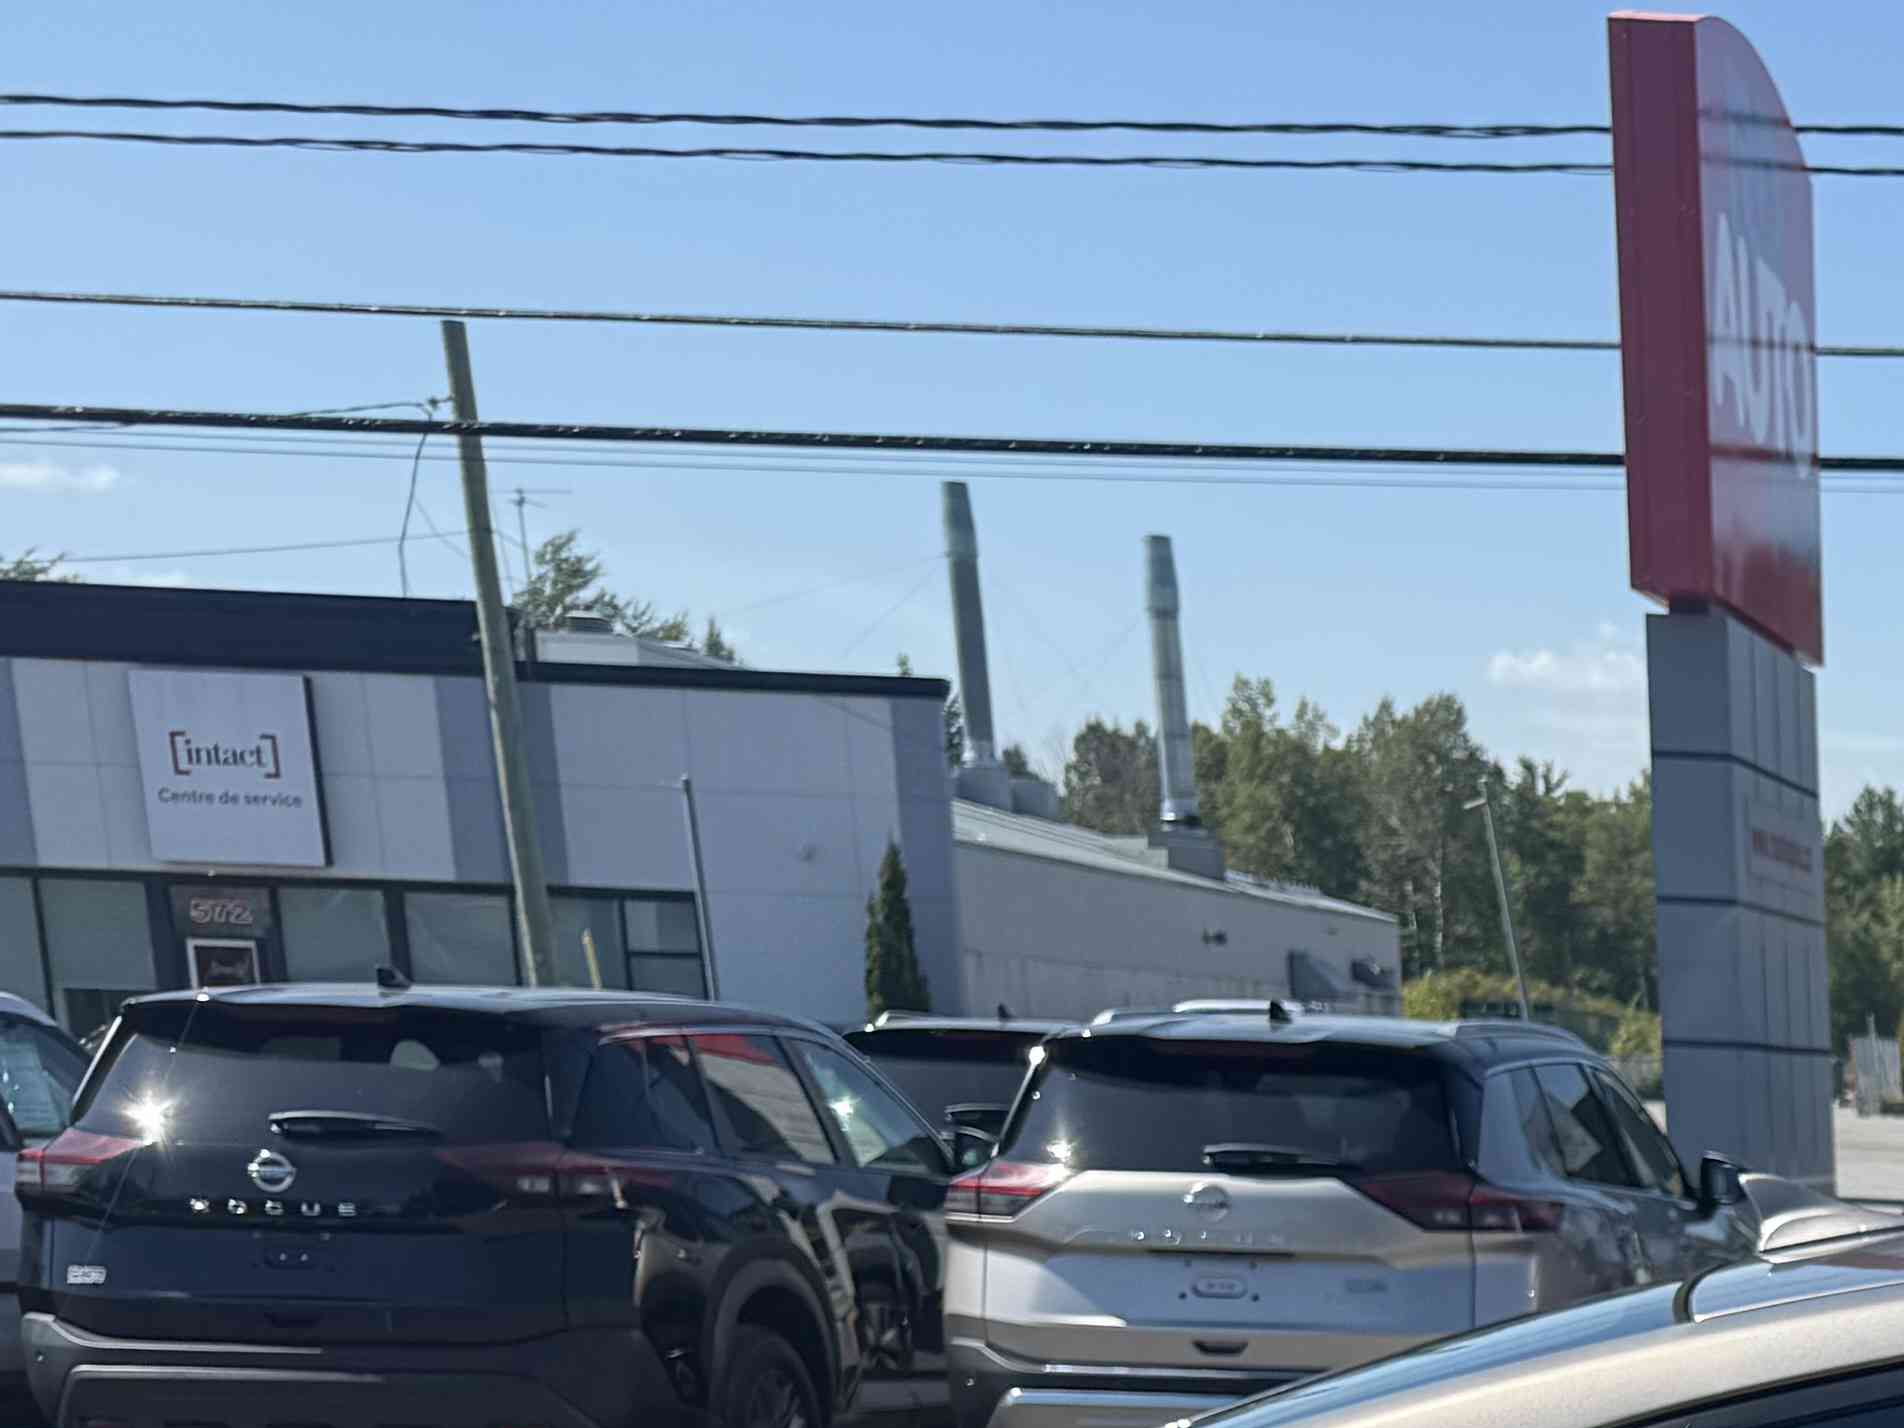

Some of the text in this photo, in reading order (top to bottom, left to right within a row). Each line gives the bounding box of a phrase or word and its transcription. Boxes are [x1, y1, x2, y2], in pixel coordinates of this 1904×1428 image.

[1713, 212, 1812, 479] AUTO
[158, 786, 303, 808] Centre de service
[190, 899, 254, 926] 572
